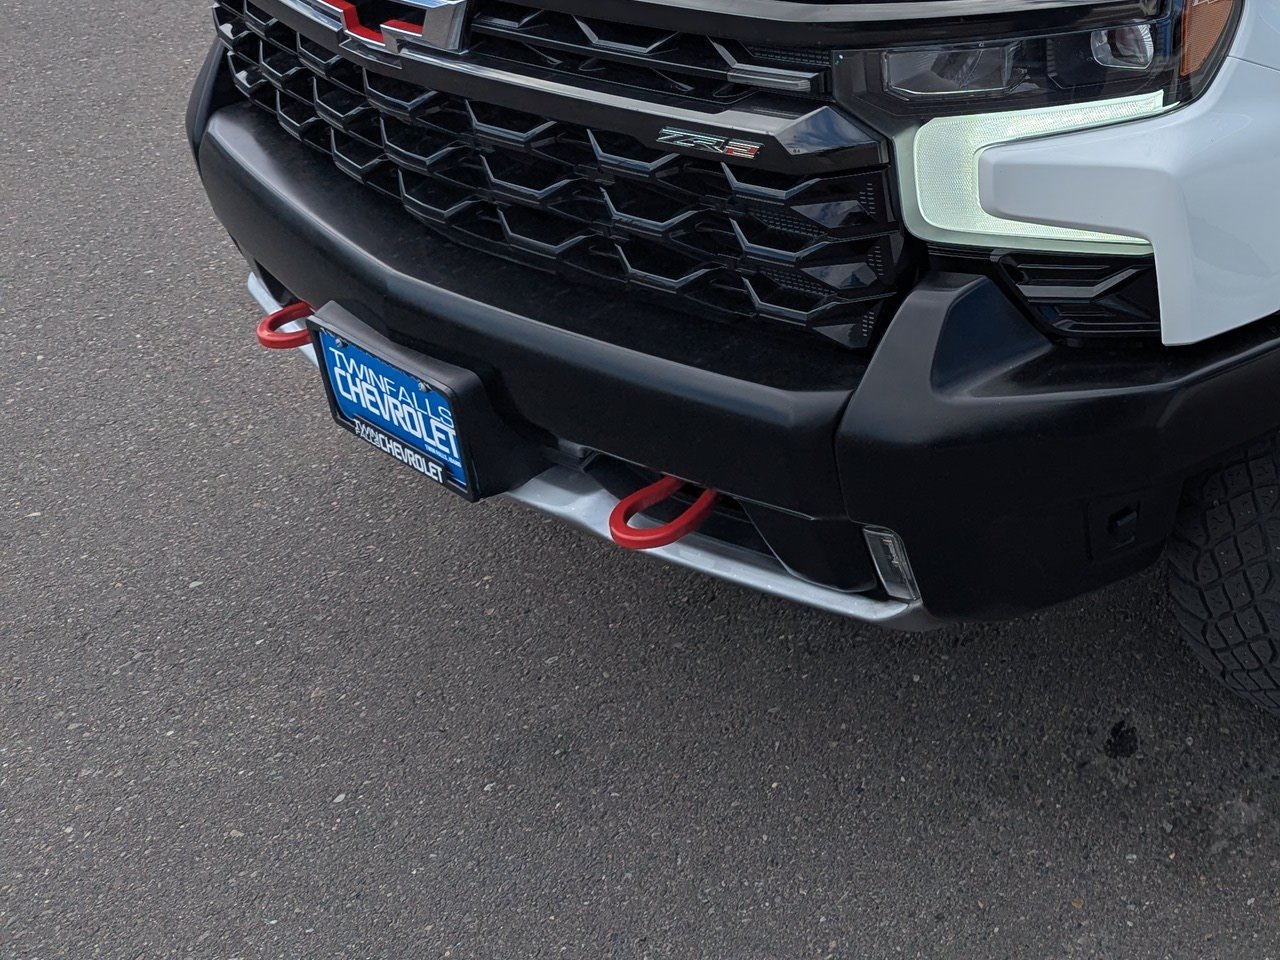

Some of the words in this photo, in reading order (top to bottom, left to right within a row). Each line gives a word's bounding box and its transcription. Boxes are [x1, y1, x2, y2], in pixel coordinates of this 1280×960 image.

[655, 126, 762, 160] ZR2
[333, 367, 460, 459] CHEVROLET
[378, 433, 443, 483] CHEVROLET
